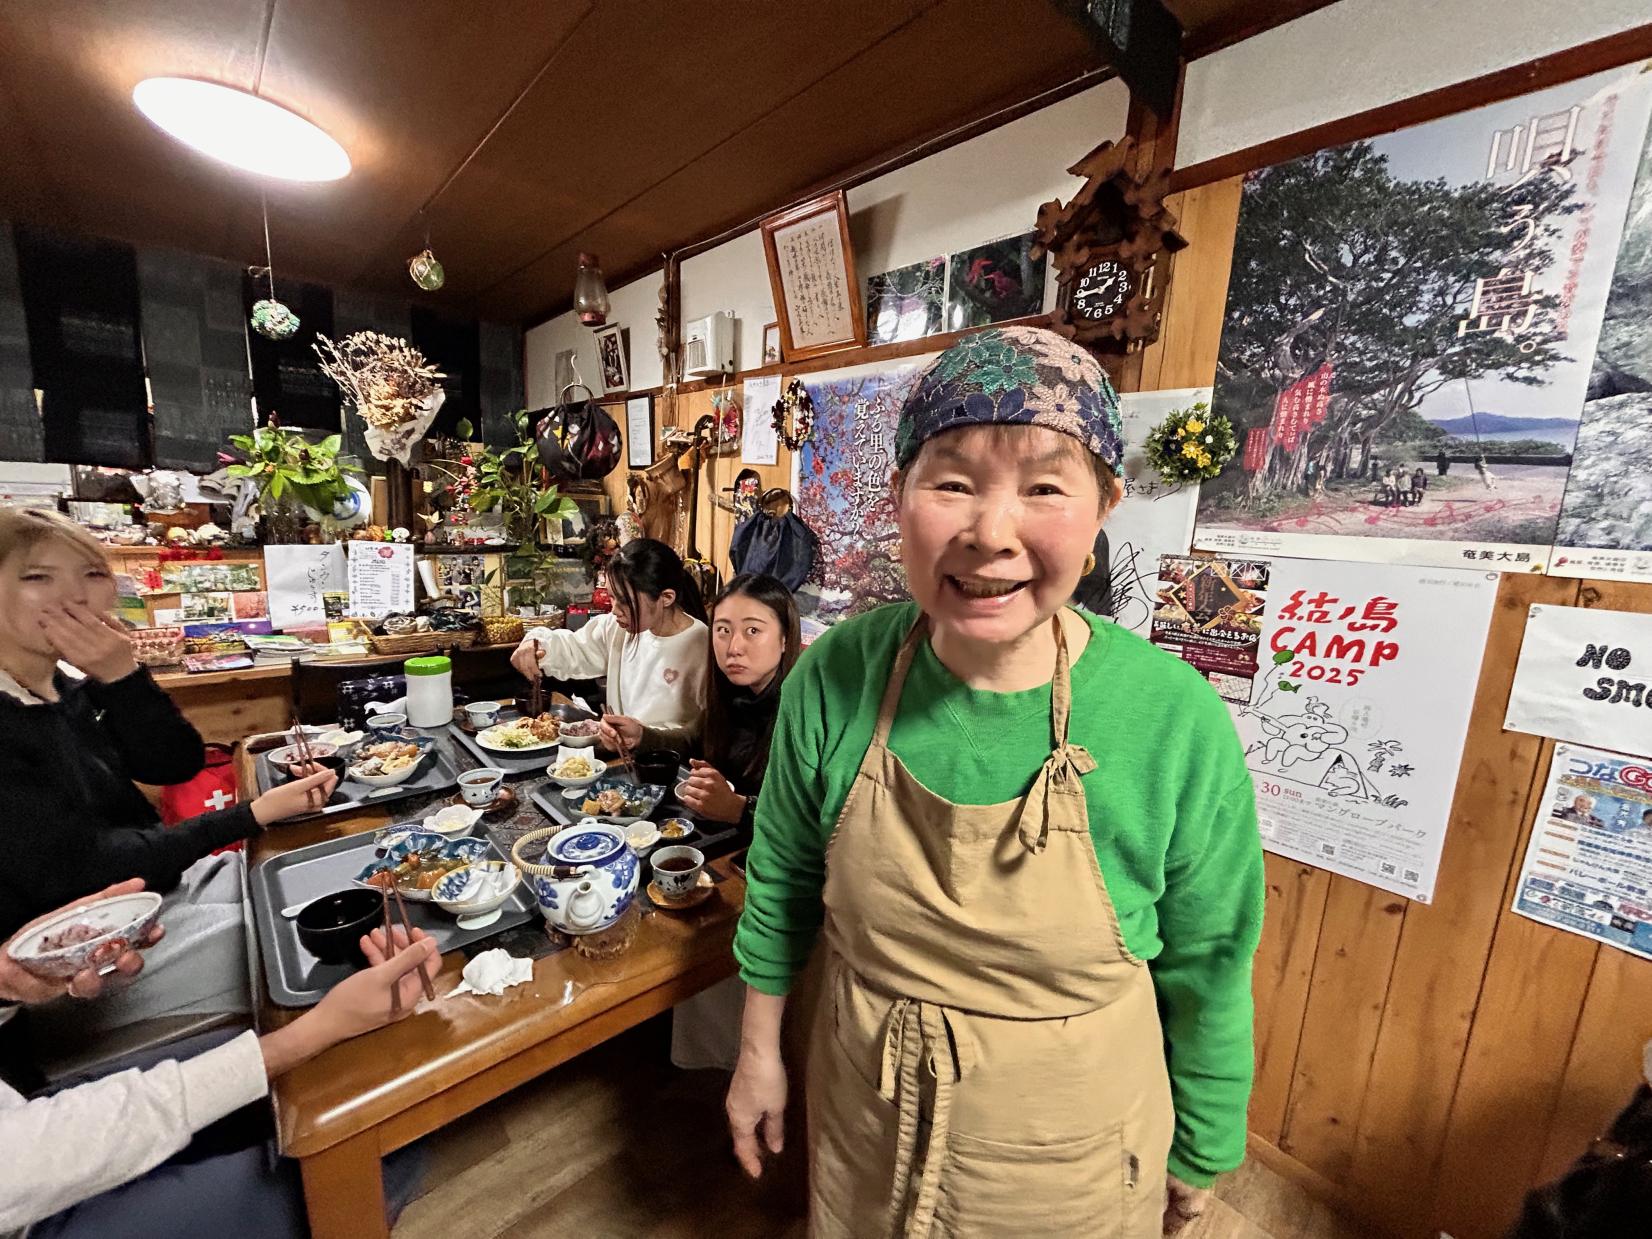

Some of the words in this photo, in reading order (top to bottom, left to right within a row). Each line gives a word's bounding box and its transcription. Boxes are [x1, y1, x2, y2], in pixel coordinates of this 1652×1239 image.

[1089, 267, 1097, 277] 11
[1099, 262, 1110, 273] 12
[1112, 262, 1118, 273] 1
[1118, 270, 1127, 281] 2
[1080, 277, 1089, 288] 10
[1118, 281, 1128, 292] 3
[1077, 299, 1086, 309] 8
[1113, 294, 1122, 304] 4
[1084, 307, 1093, 317] 7
[1093, 309, 1102, 318] 6
[1104, 304, 1113, 314] 5
[867, 397, 886, 512] ふる里の色を
[1462, 549, 1531, 563] 奄美大島
[1270, 626, 1400, 667] CAMP
[1575, 643, 1632, 670] NO
[1289, 660, 1366, 687] 2025
[1582, 677, 1652, 709] SM
[1569, 758, 1652, 793] つなG
[1261, 781, 1281, 797] 30
[1283, 787, 1303, 799] sun
